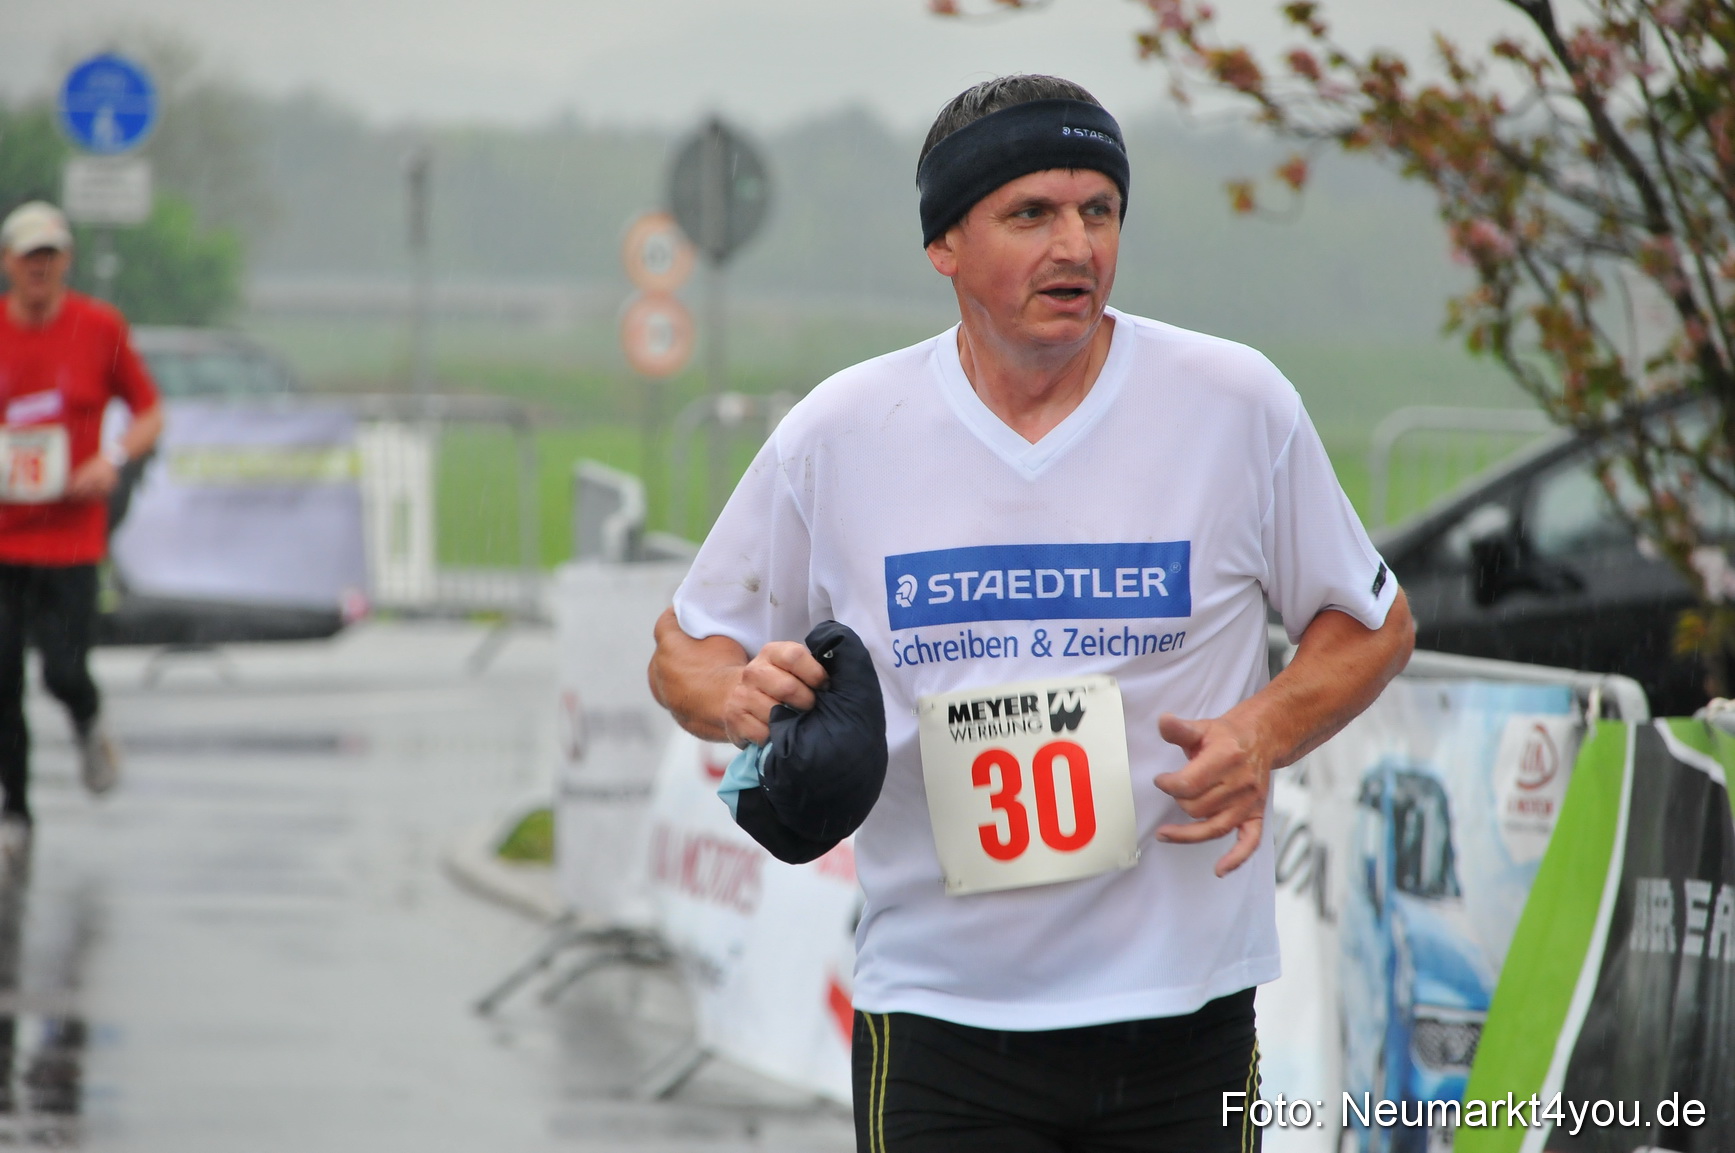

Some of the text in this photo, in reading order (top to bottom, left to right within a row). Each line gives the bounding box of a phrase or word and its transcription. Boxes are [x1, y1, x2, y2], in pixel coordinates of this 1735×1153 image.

[928, 567, 1169, 605] STAEDTLER
[893, 626, 1186, 669] Schreiben & Zeichnen
[947, 693, 1040, 724] MEYER
[949, 715, 1044, 744] WERBUNG
[971, 740, 1096, 863] 30
